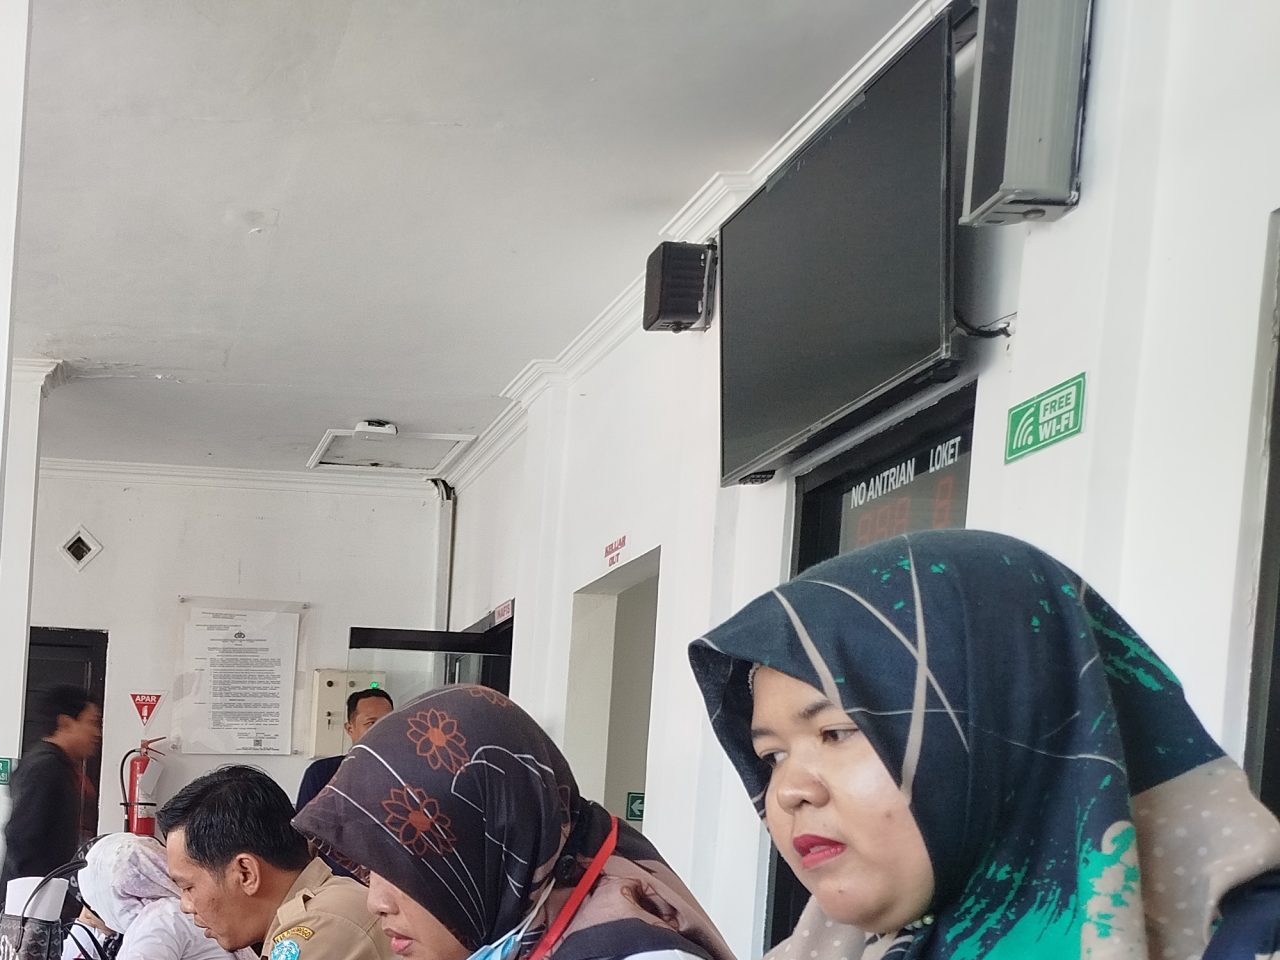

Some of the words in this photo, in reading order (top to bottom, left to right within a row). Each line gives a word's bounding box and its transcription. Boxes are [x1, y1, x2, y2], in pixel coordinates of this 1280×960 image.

[1042, 391, 1073, 418] FREE
[1039, 409, 1075, 442] WI-FI
[851, 481, 867, 510] NO
[867, 457, 916, 503] ANTRIAN
[929, 435, 962, 474] LOKET
[135, 695, 157, 703] APAR
